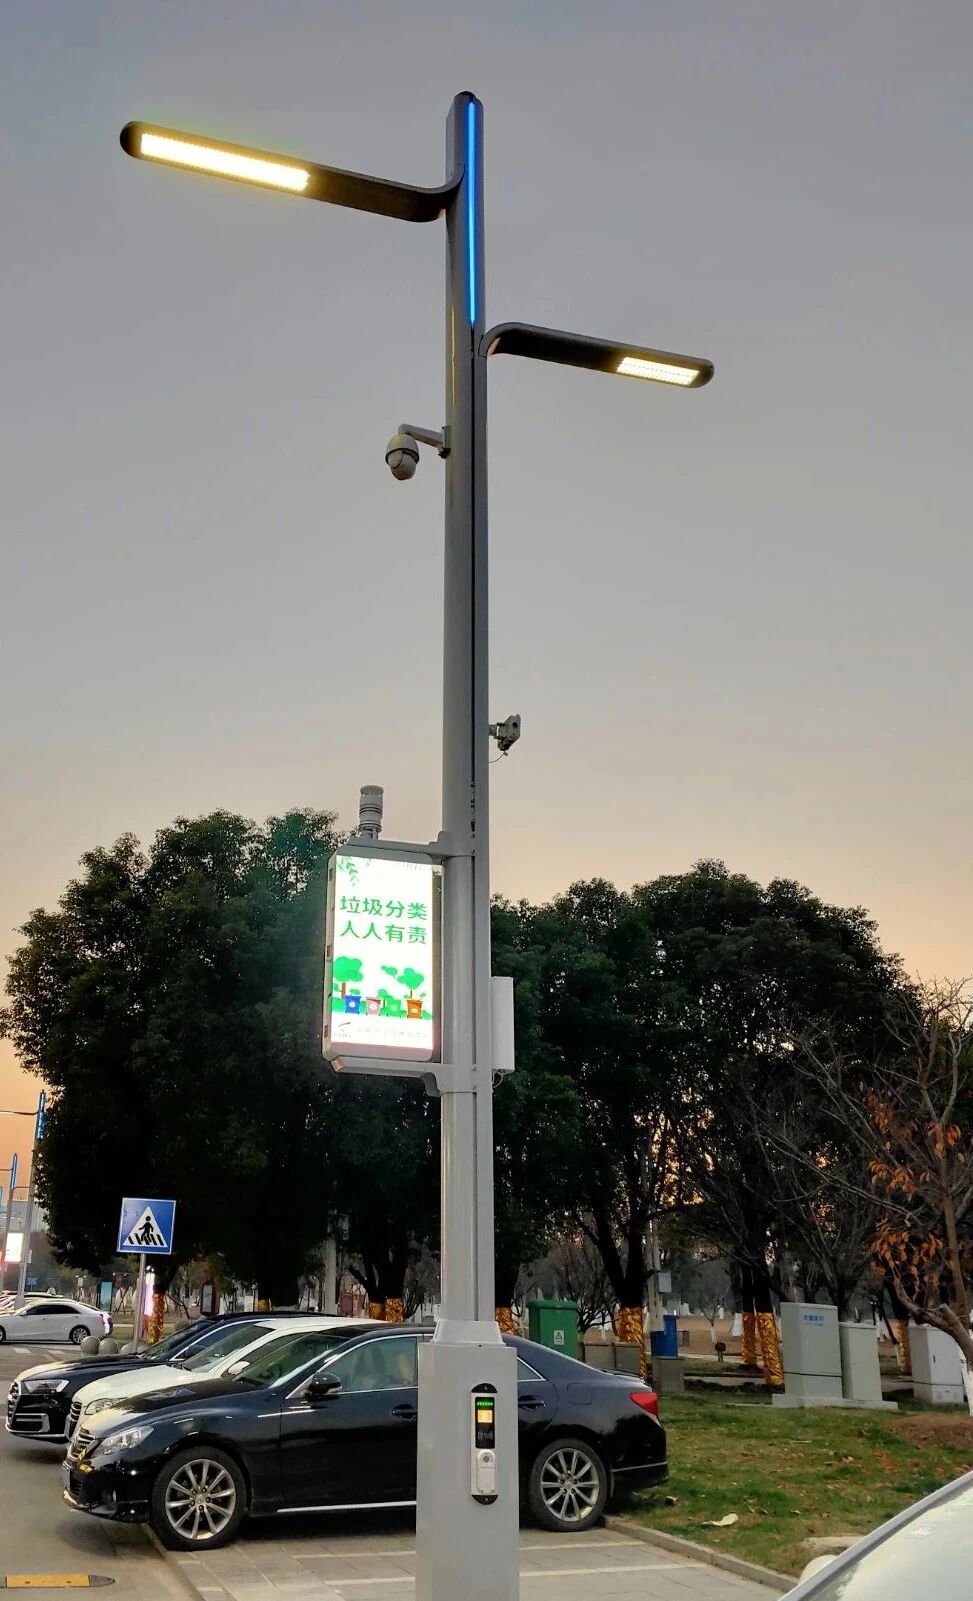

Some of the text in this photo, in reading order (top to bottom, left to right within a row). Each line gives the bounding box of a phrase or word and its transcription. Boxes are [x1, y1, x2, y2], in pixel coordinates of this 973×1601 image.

[340, 896, 428, 921] 垃圾分类
[340, 920, 428, 945] 人人有责
